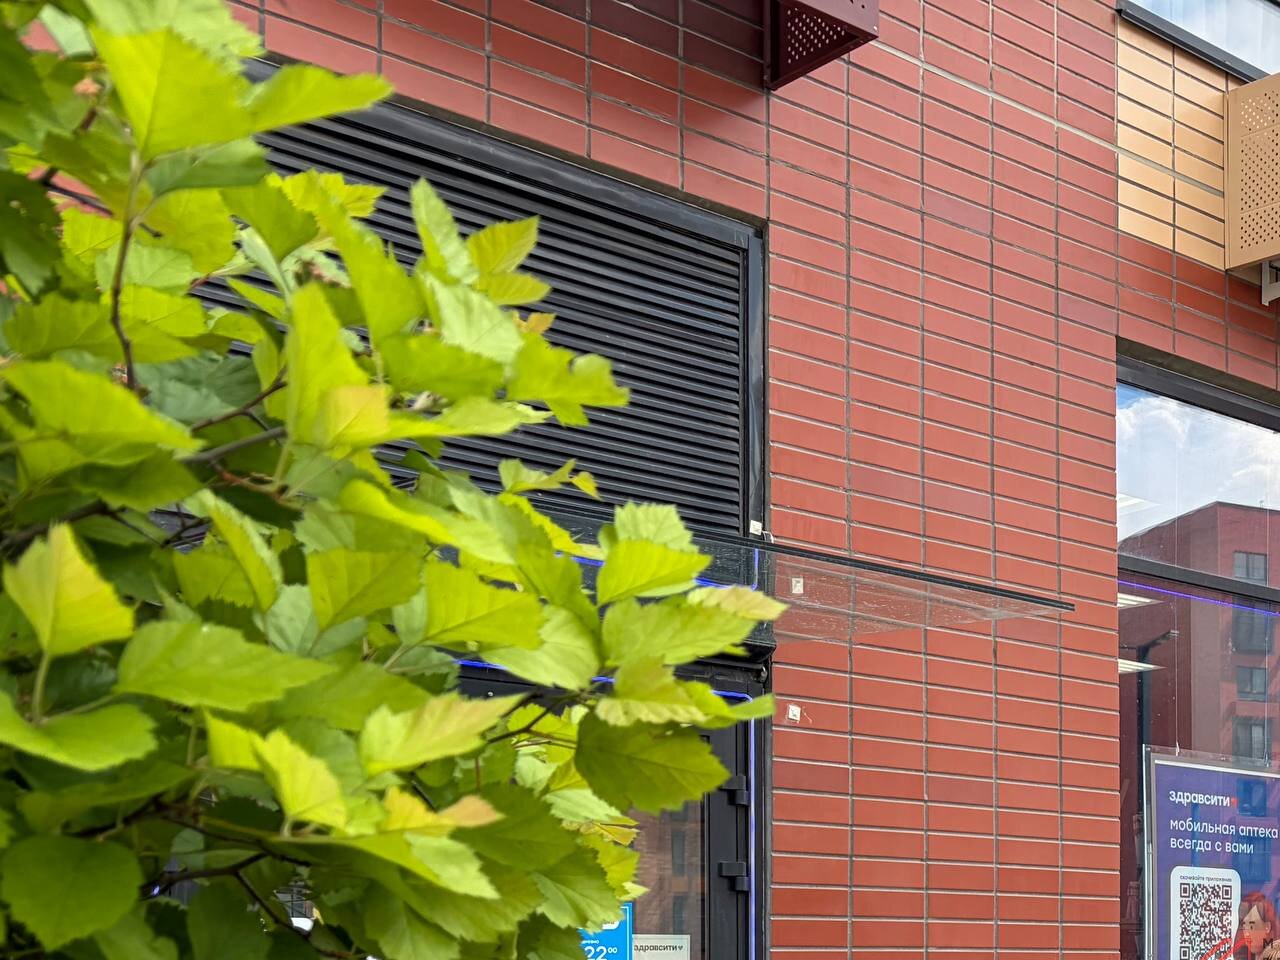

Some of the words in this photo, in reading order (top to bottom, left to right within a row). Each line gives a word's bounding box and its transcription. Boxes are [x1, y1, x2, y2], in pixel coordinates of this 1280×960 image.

[1169, 790, 1231, 807] здравсити
[1170, 817, 1236, 836] мобильная
[1239, 825, 1279, 839] аптека
[1170, 837, 1212, 853] всегда
[1215, 841, 1222, 852] с
[1225, 842, 1254, 854] вами
[634, 944, 678, 952] здравсити
